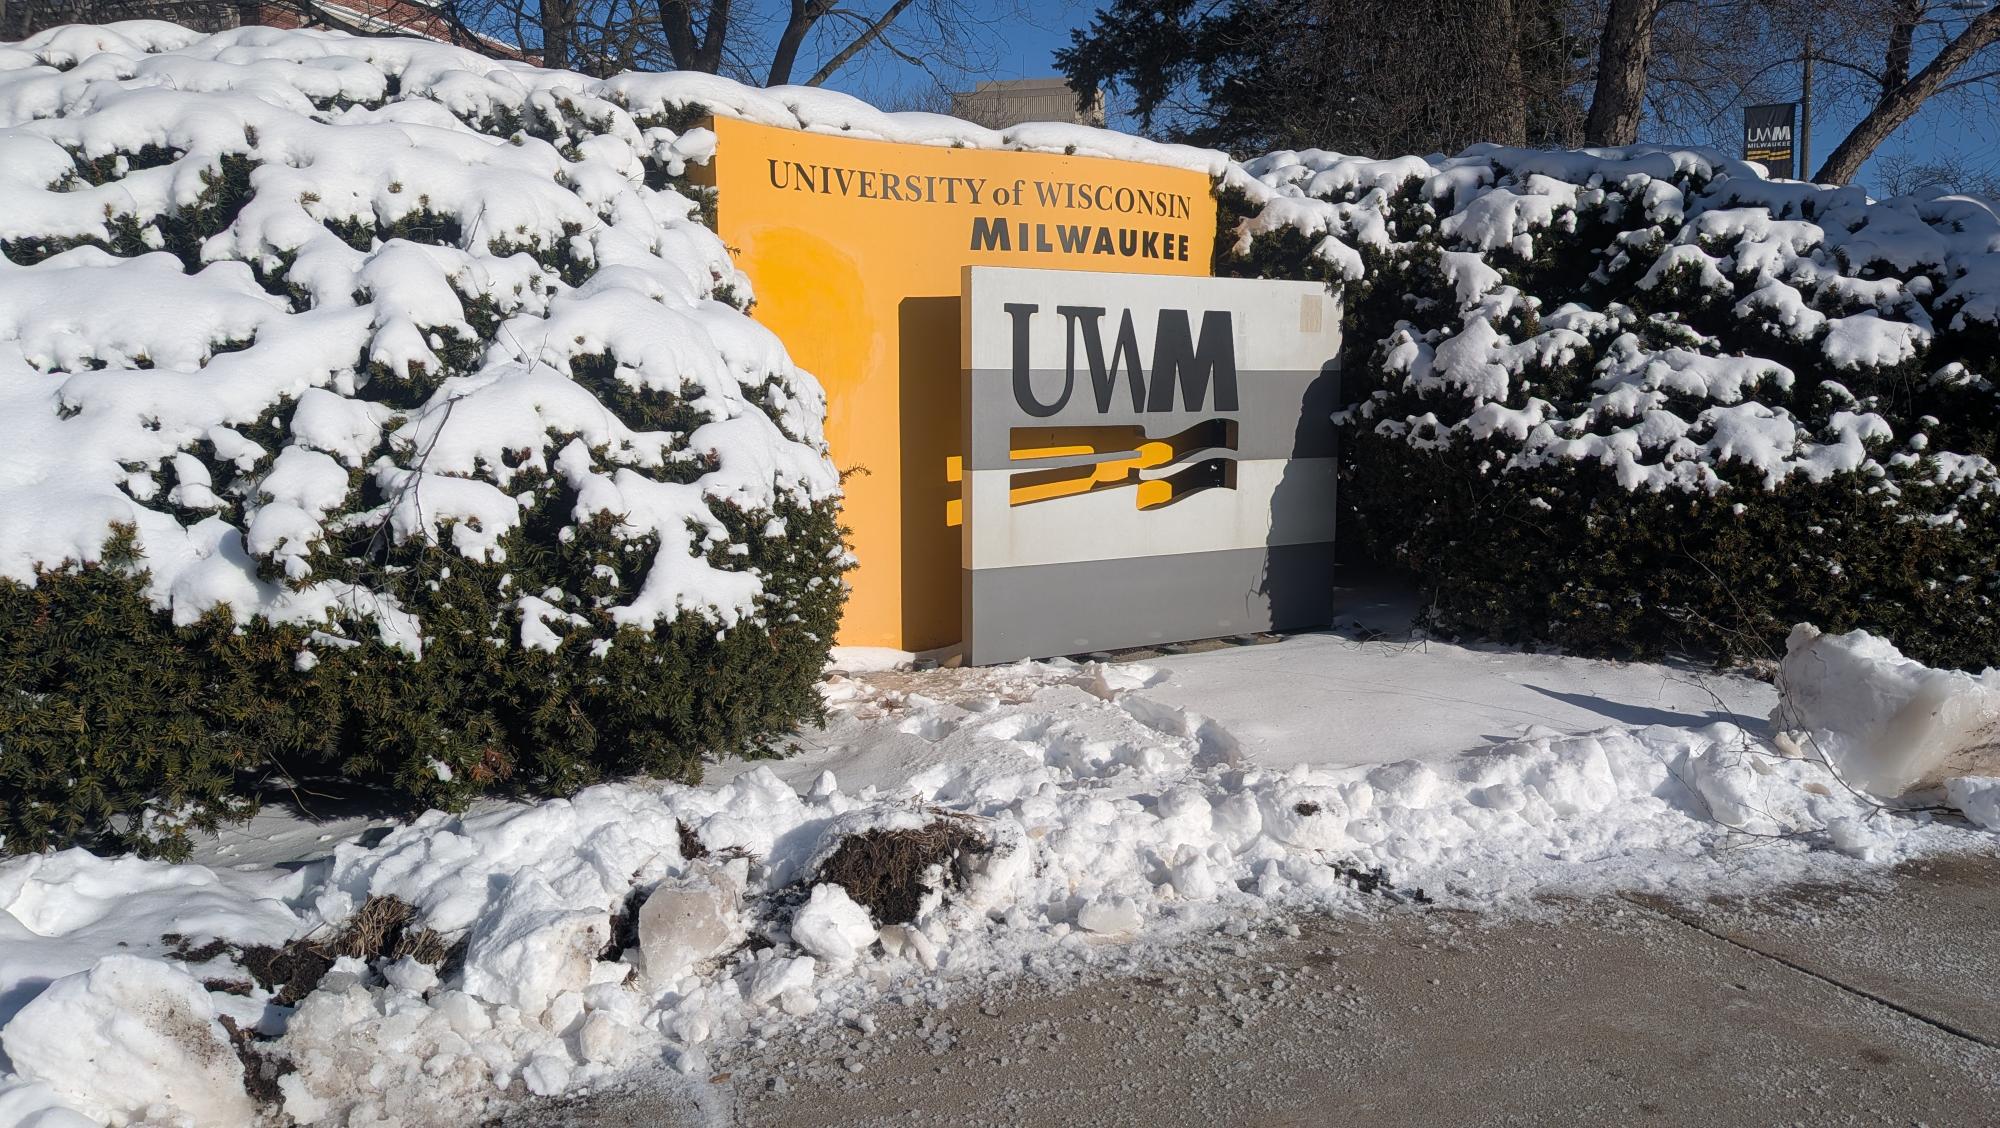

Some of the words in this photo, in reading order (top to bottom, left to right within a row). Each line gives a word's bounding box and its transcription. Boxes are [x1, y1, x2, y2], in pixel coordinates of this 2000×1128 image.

[1747, 141, 1791, 149] MILWAUKEE
[1748, 126, 1791, 142] UWM
[767, 159, 987, 205] UNIVERSITY
[992, 179, 1025, 207] of
[1034, 181, 1191, 220] WISCONSIN
[970, 217, 1189, 262] MILWAUKEE
[1004, 303, 1239, 417] UWM
